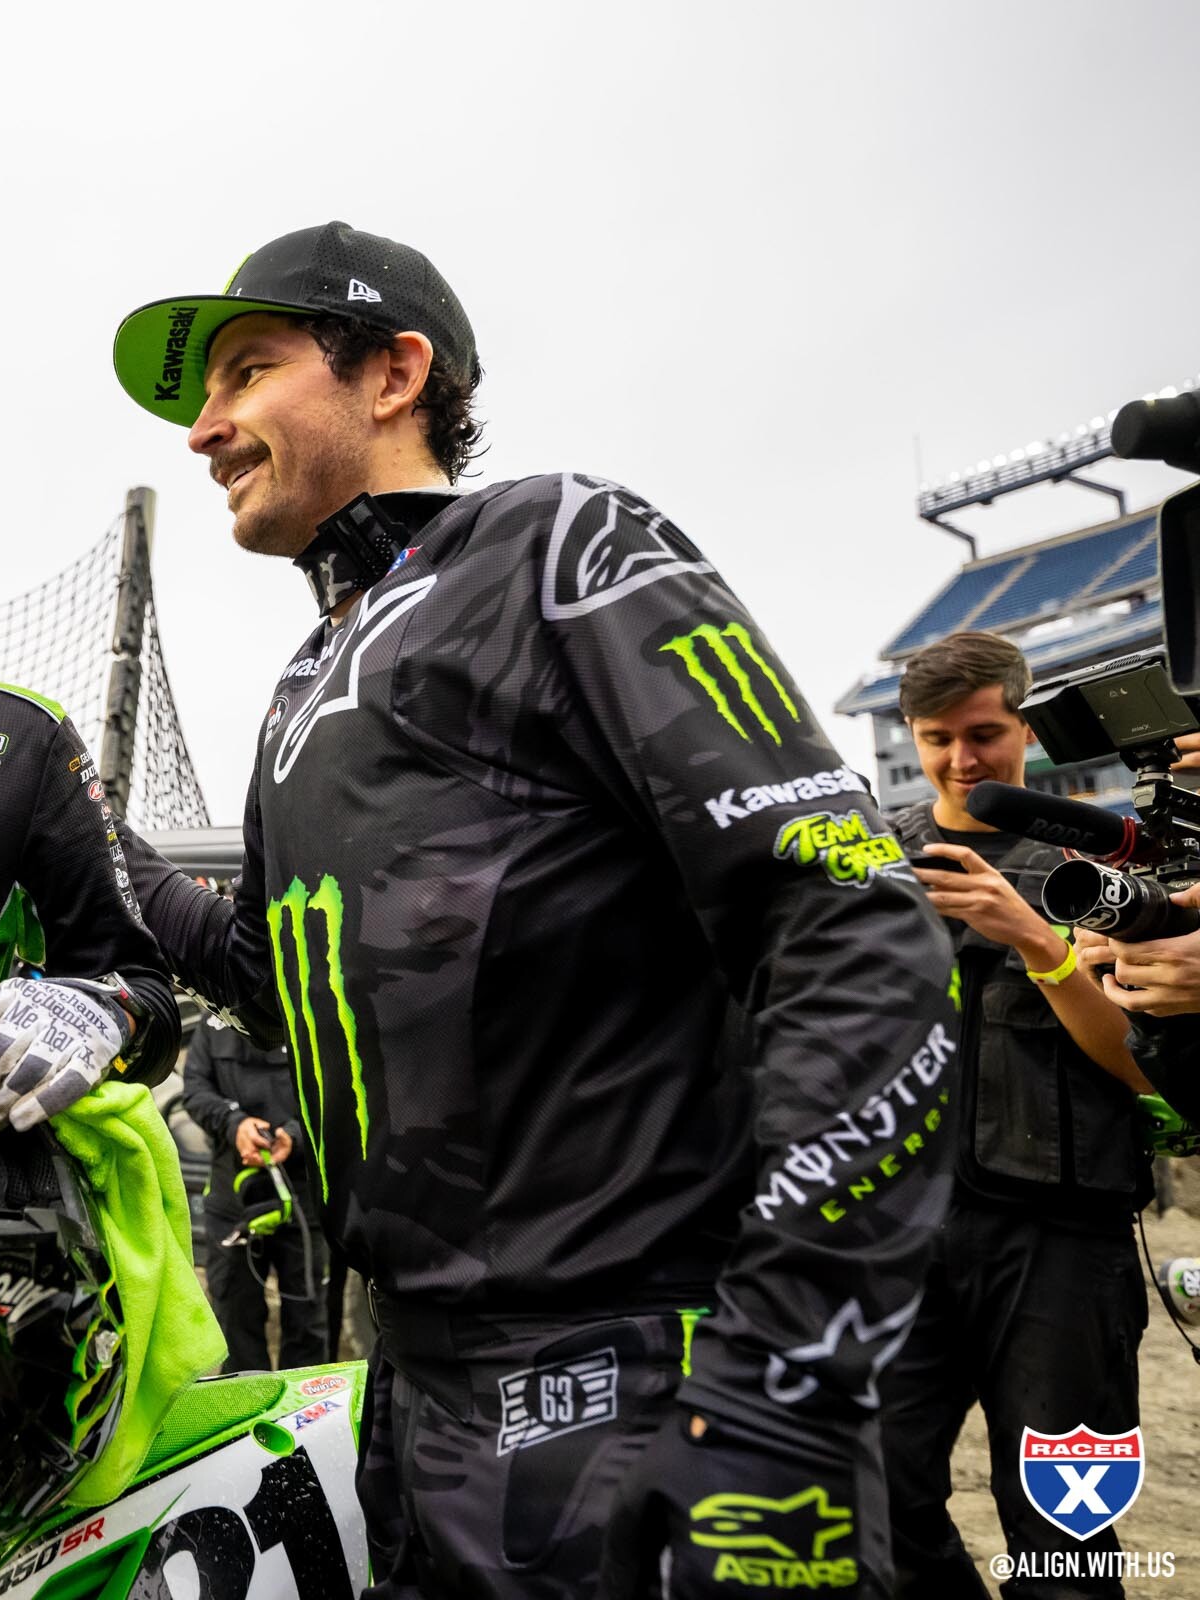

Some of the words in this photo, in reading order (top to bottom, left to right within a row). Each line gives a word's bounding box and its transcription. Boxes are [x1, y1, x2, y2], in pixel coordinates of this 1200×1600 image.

[154, 306, 199, 402] Kawasaki
[754, 1023, 957, 1221] MONSTER
[540, 1374, 574, 1423] 63
[713, 1554, 859, 1589] ASTARS
